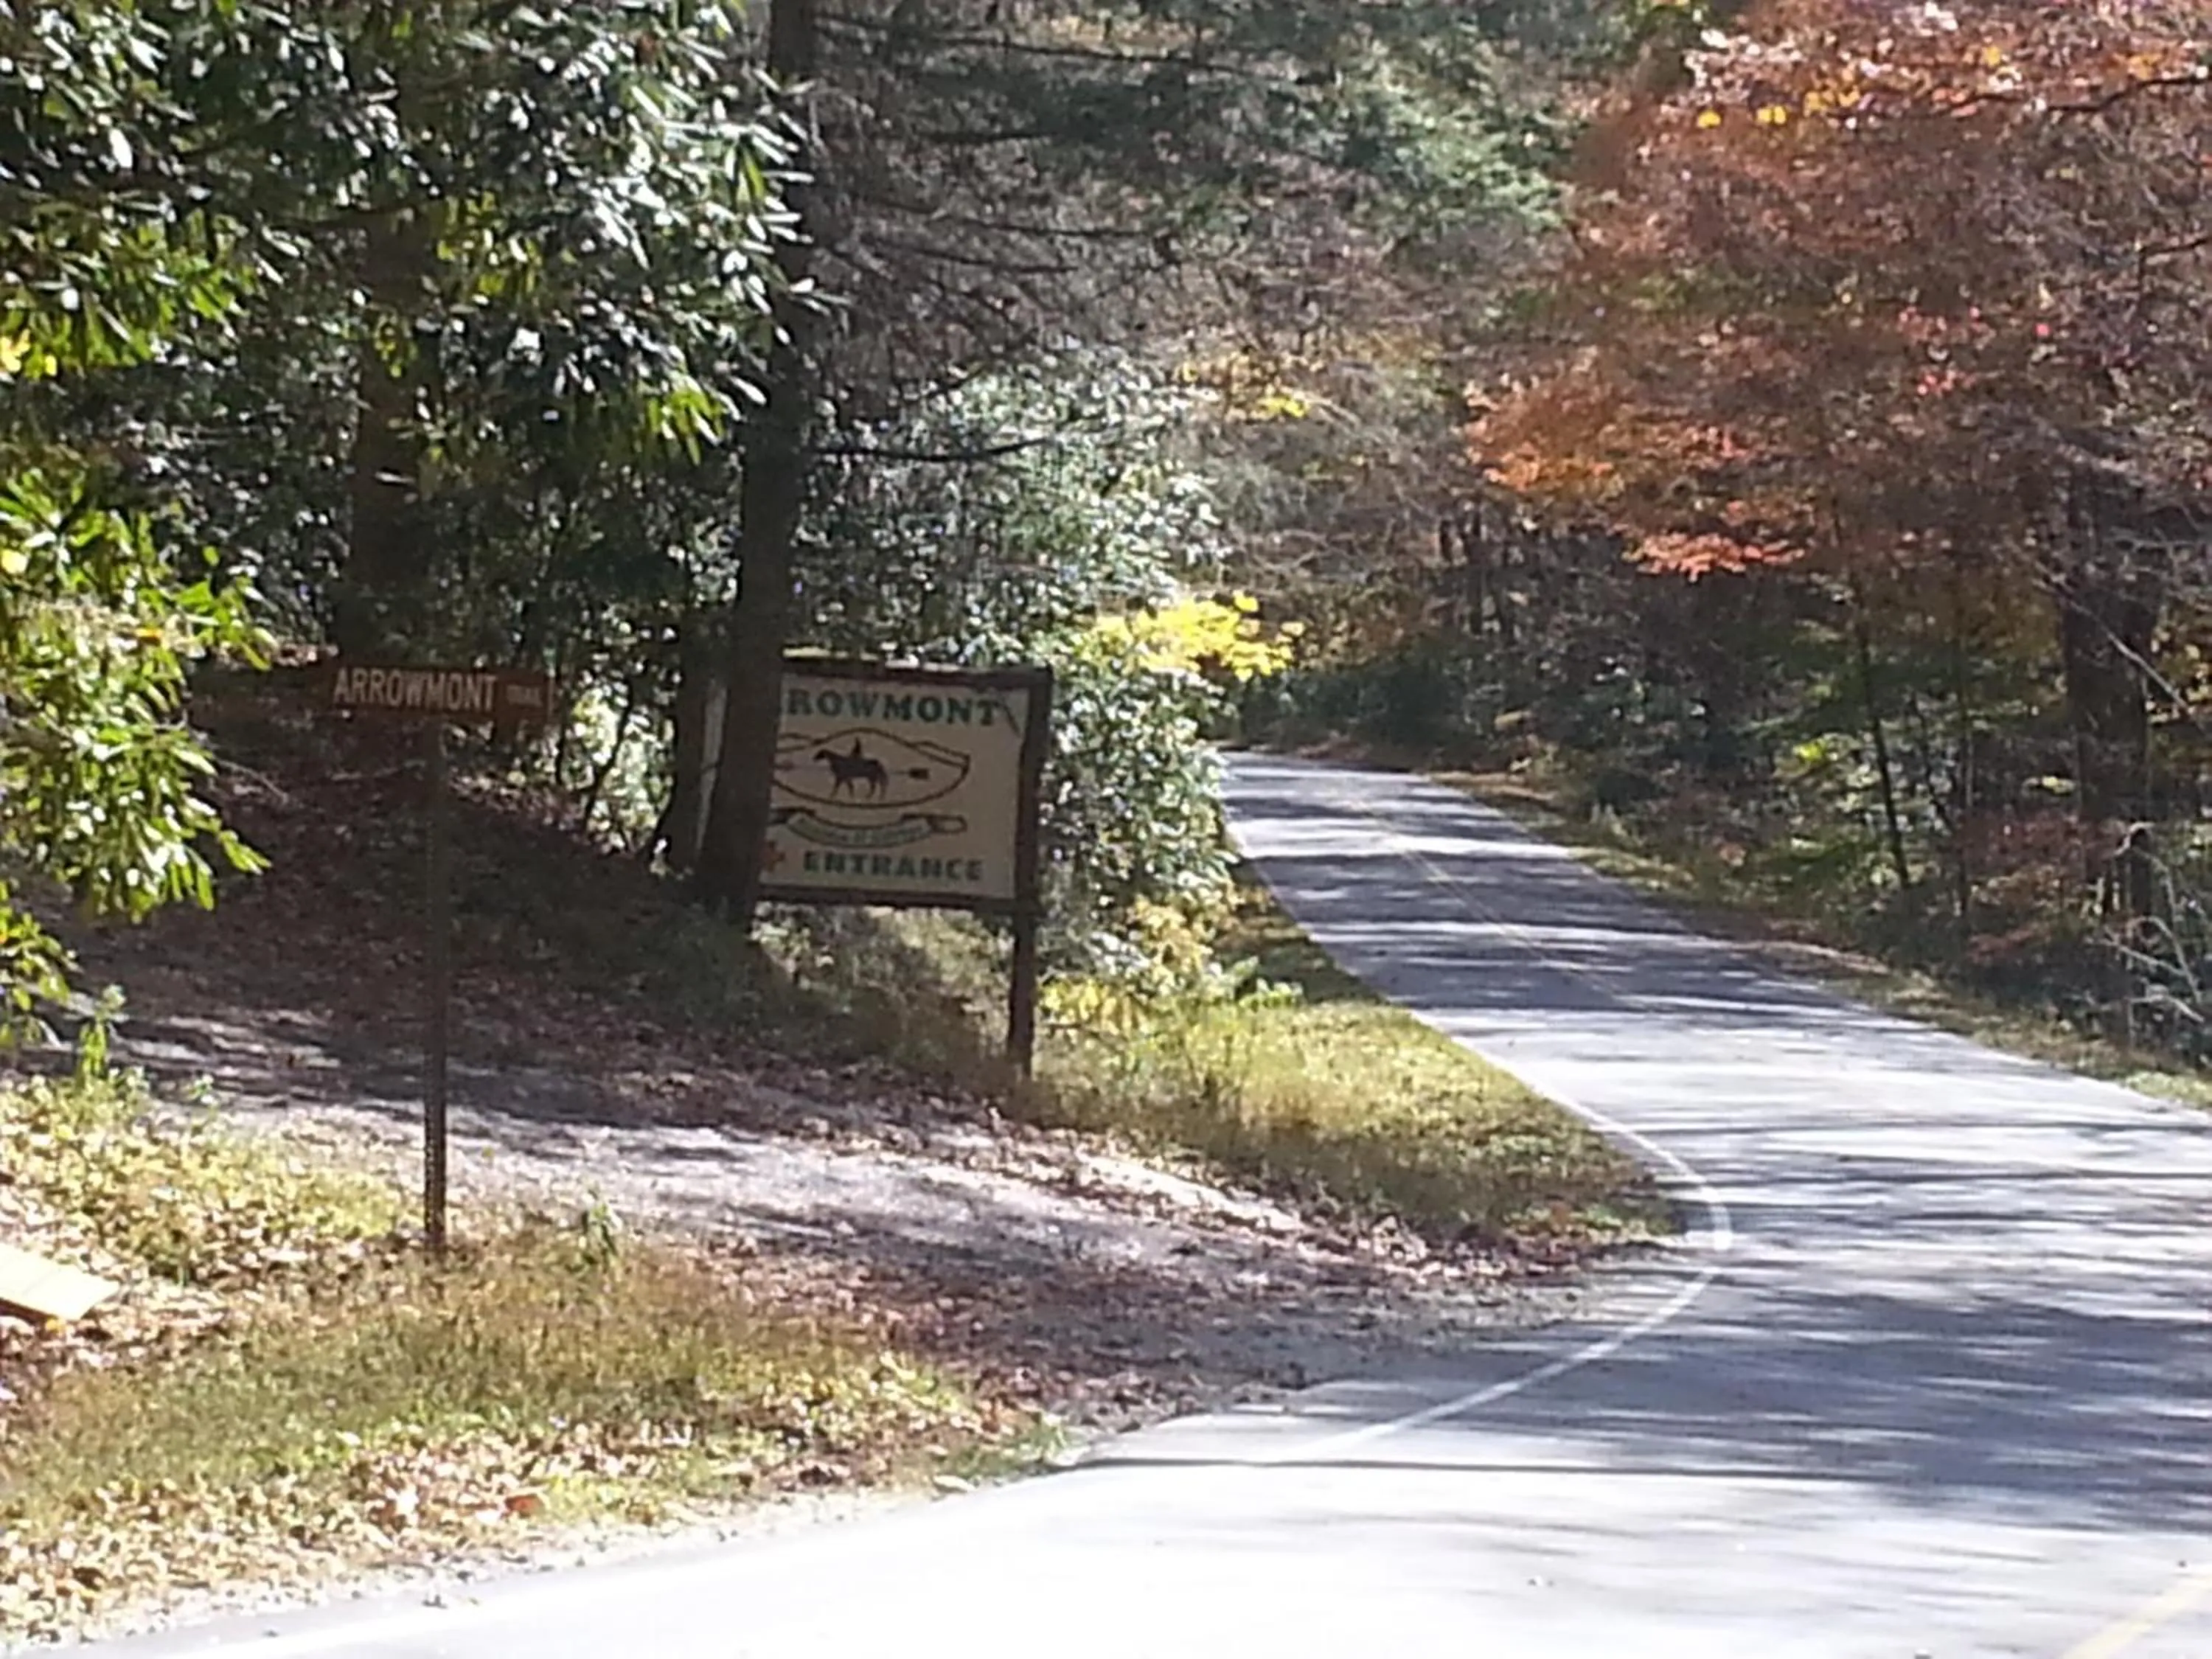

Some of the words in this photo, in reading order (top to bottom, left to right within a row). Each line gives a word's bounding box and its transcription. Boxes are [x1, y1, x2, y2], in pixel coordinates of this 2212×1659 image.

[333, 668, 498, 712] ARROWMONT
[779, 688, 998, 726] ROWMONT
[804, 850, 983, 880] ENTRANCE
